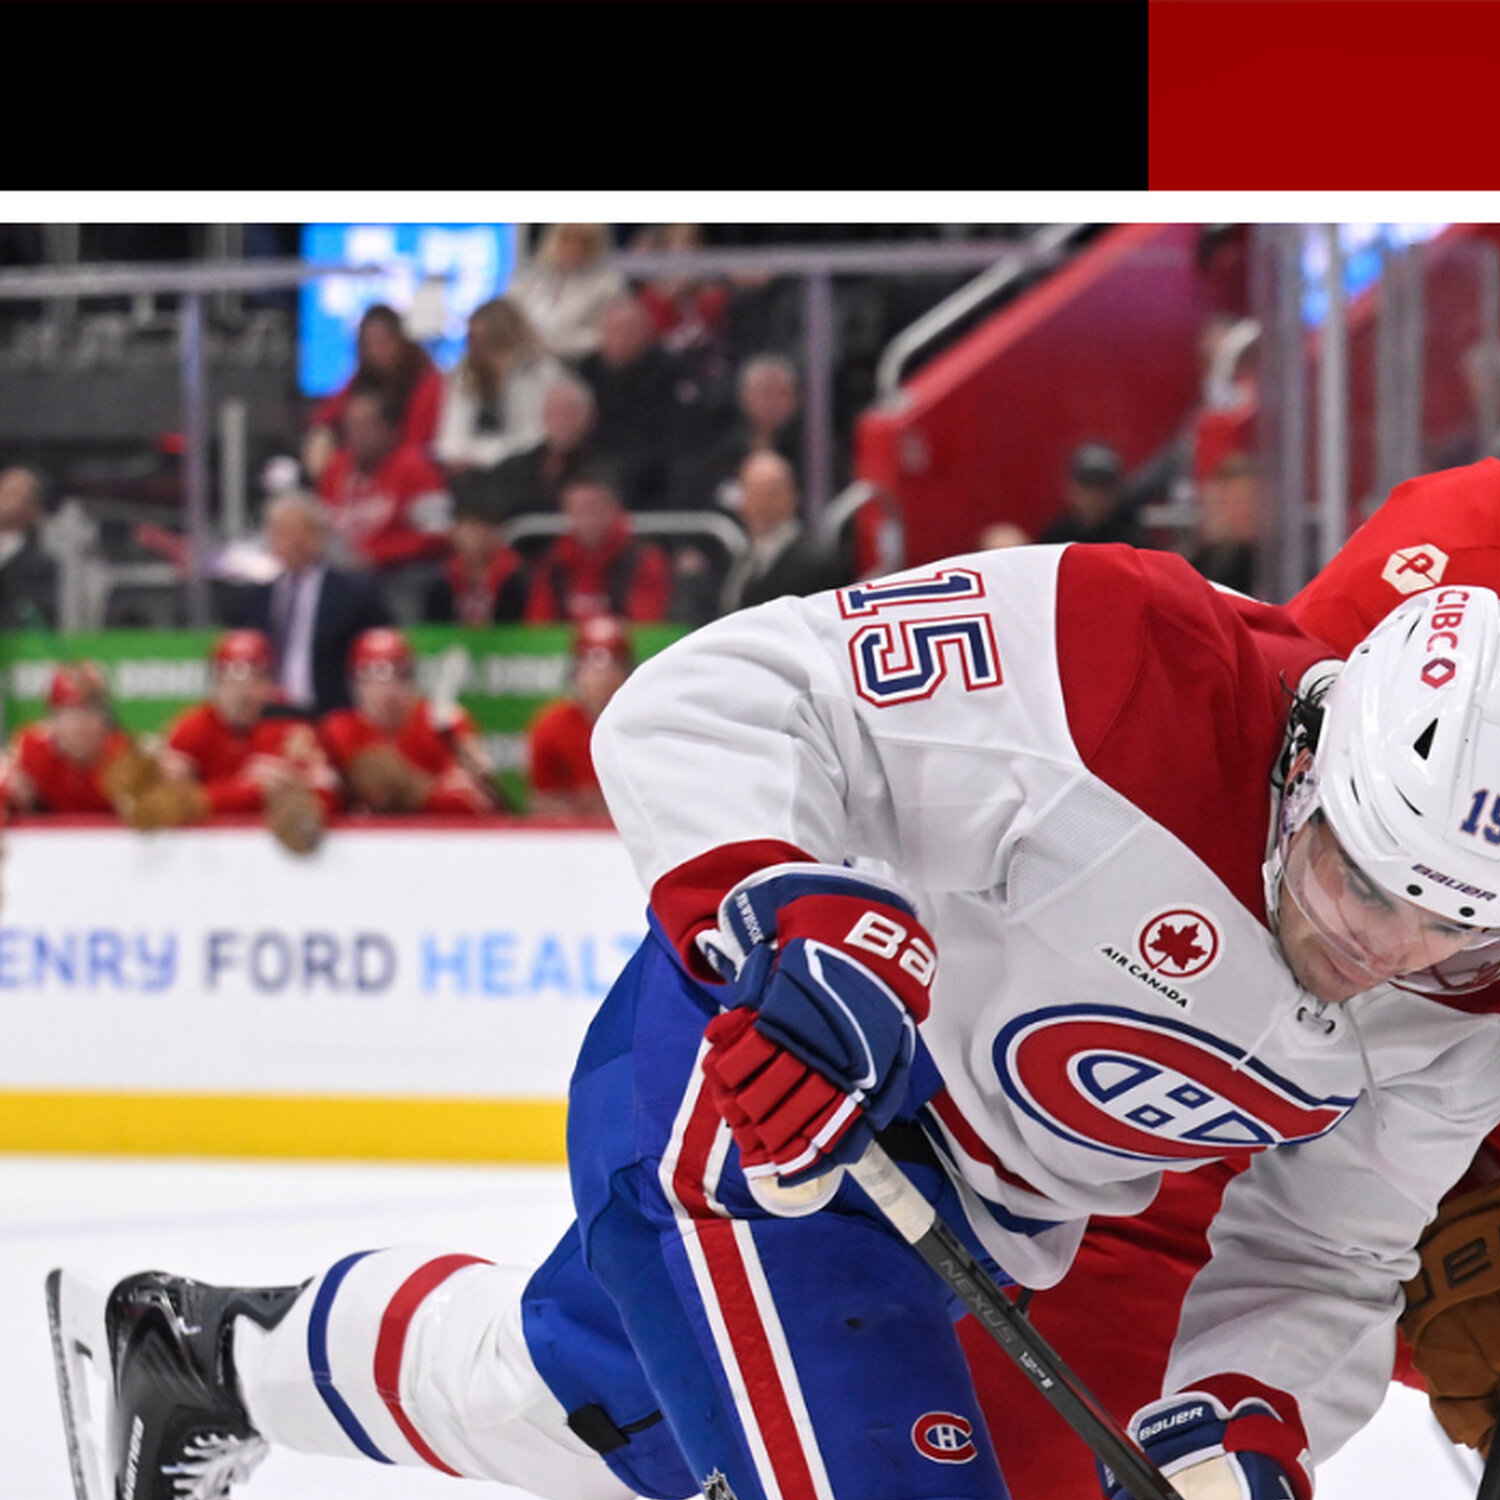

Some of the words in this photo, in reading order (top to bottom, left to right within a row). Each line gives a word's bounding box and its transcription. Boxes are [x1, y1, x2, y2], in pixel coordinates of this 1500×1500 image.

[836, 567, 1004, 708] 15
[1426, 589, 1470, 652] CIBC
[204, 930, 397, 994] FORD
[1101, 947, 1128, 967] AIR
[1128, 964, 1188, 1008] CANADA
[940, 1259, 1020, 1343] NEXUS
